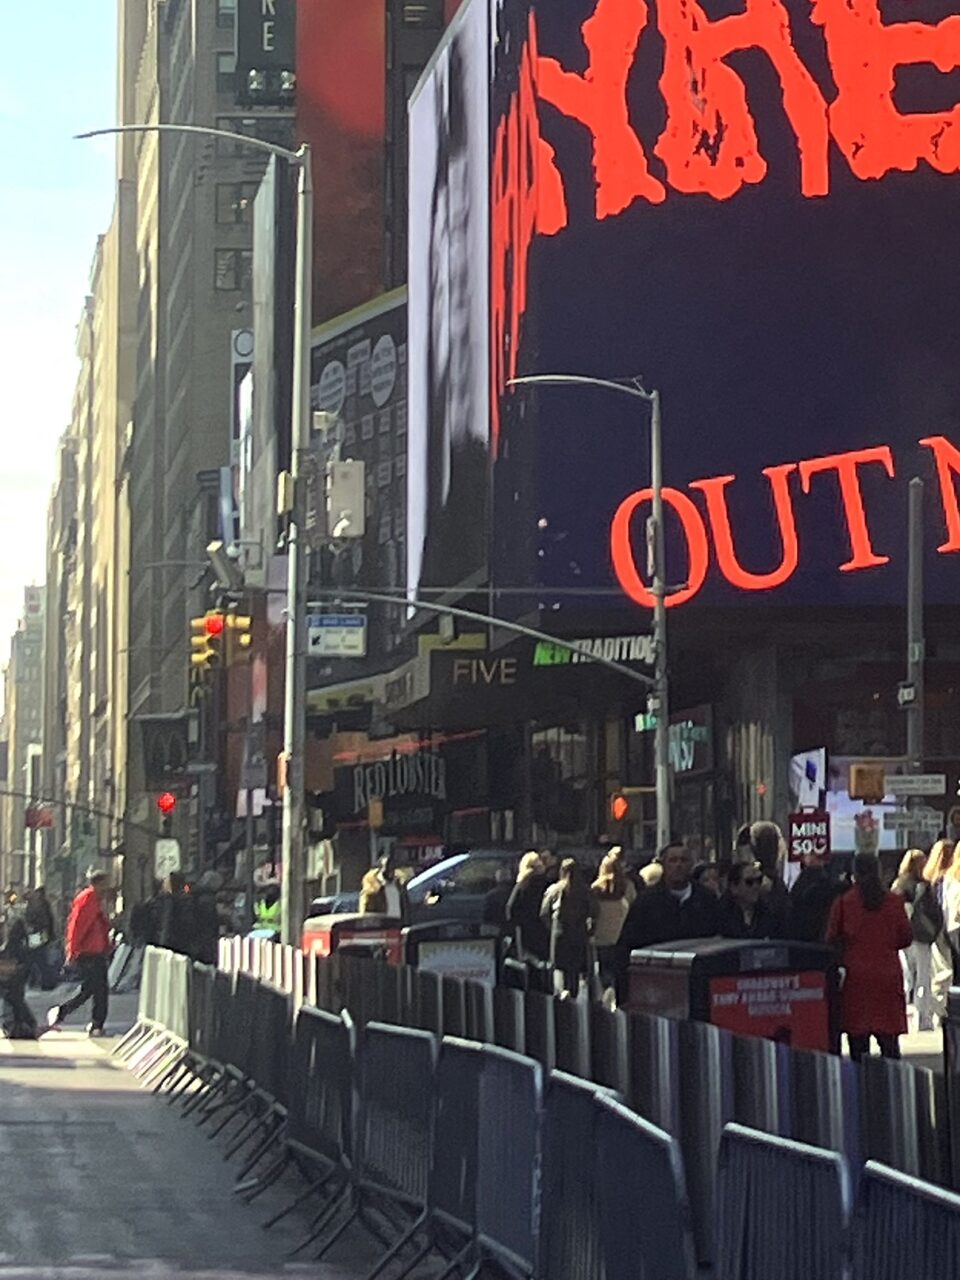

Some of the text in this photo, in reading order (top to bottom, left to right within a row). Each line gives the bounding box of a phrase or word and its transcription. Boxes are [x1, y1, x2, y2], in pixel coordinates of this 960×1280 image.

[610, 444, 895, 609] OUT
[453, 658, 518, 685] FIVE
[353, 762, 386, 814] RED
[792, 822, 827, 838] MINI
